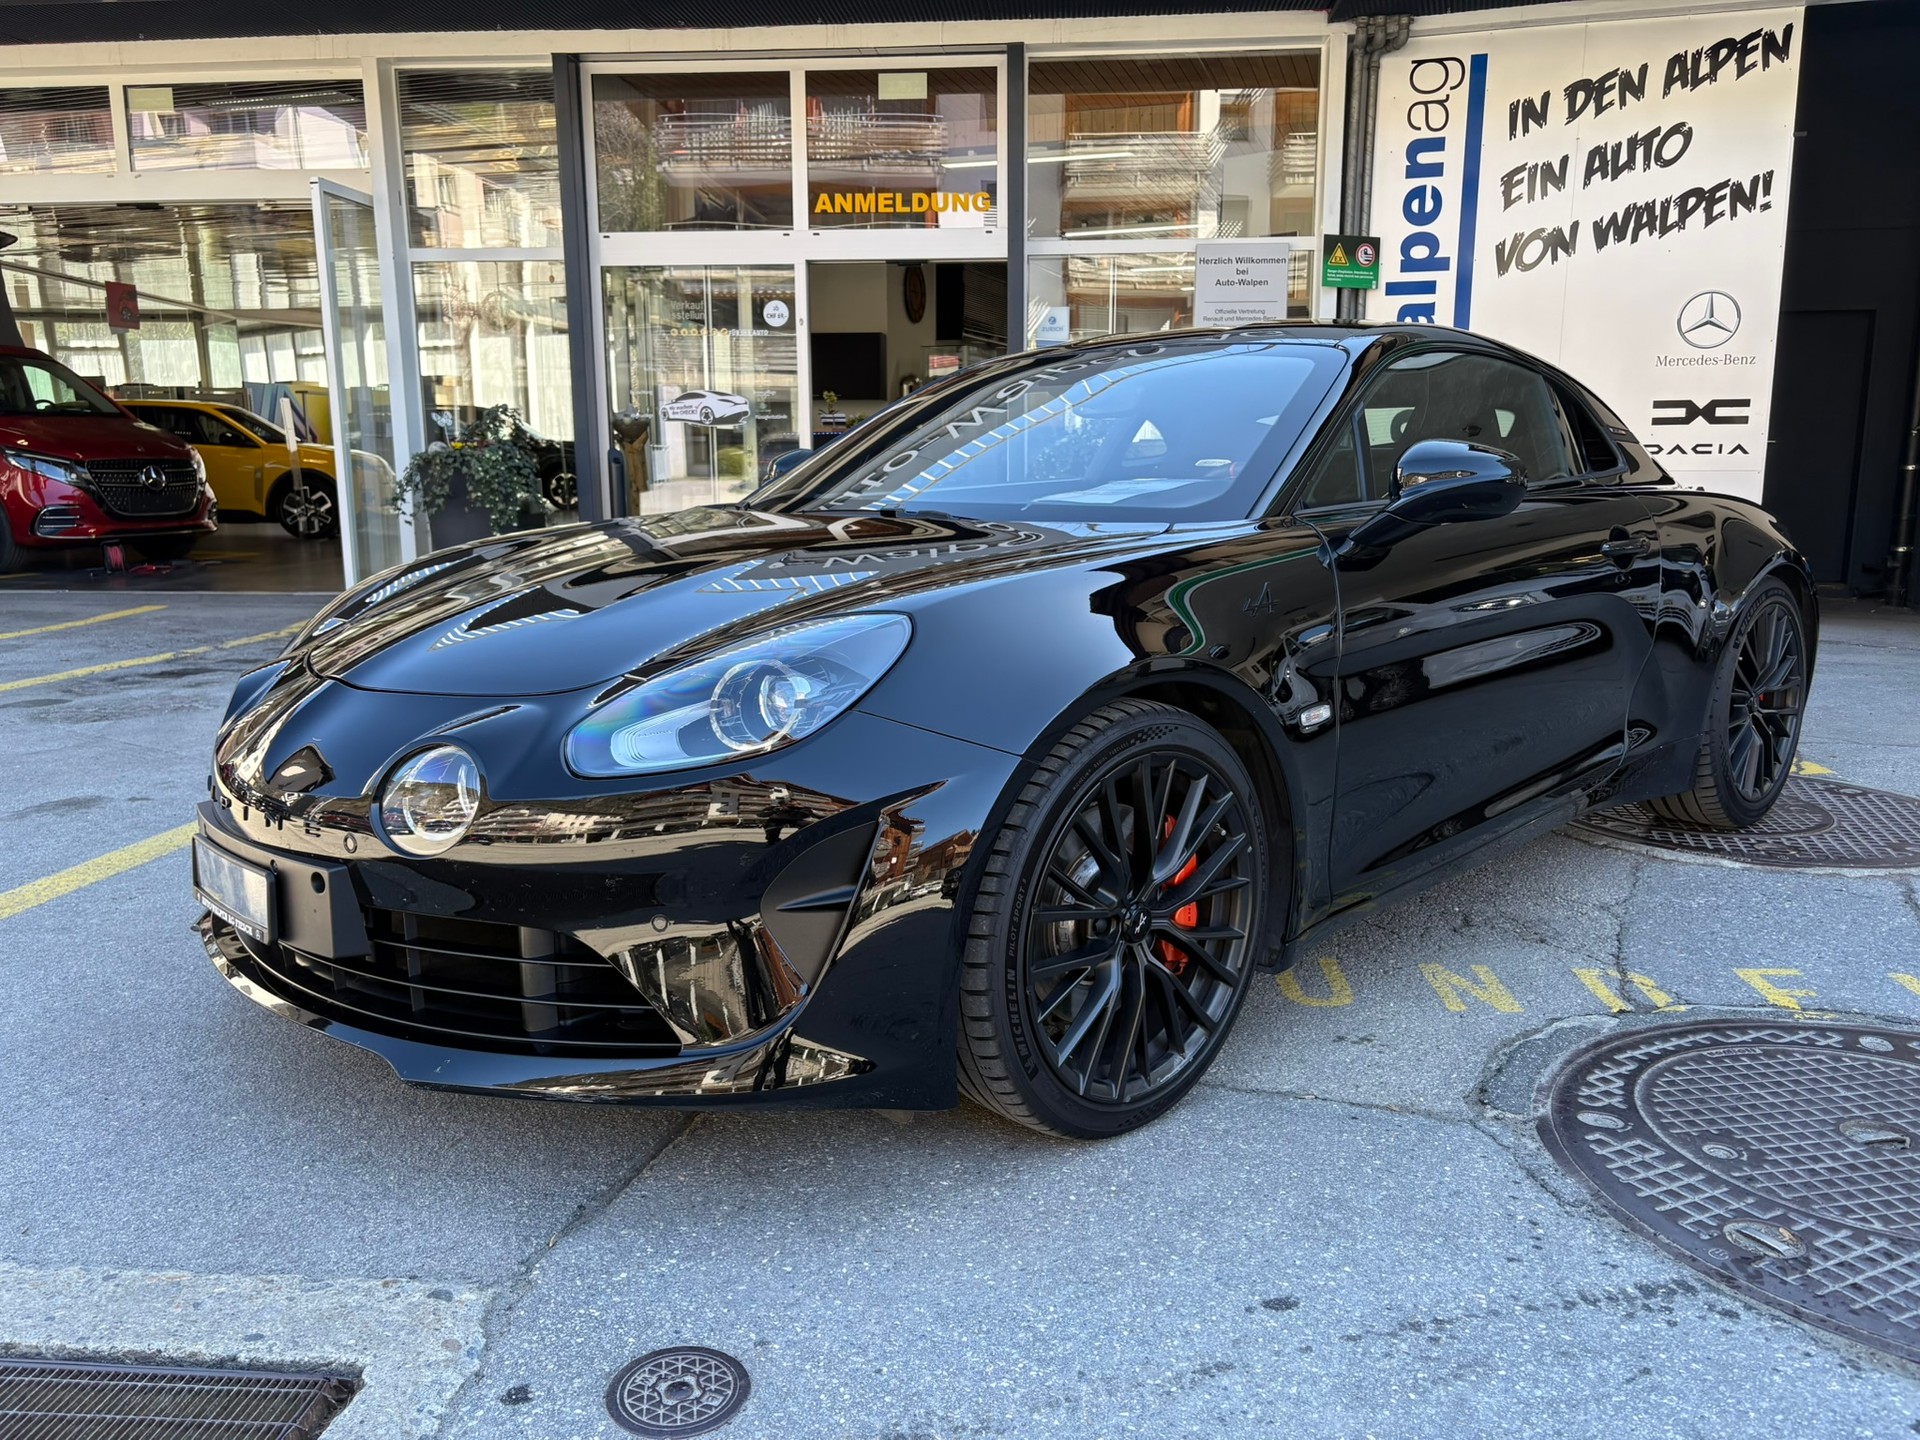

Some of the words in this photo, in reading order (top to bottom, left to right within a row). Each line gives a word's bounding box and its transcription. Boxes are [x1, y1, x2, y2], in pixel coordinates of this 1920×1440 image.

[1509, 91, 1551, 141] IN
[1564, 62, 1649, 126] DEN
[1663, 22, 1794, 100] ALPEN
[1501, 153, 1570, 212] EIN
[1583, 121, 1693, 190] AUTO
[814, 191, 991, 213] ANMELDUNG
[1496, 219, 1580, 278] VON
[1593, 169, 1775, 253] WALPEN!
[1199, 256, 1233, 265] Herzlich
[1235, 255, 1287, 264] Willkommen
[1236, 267, 1249, 275] bei
[1215, 278, 1269, 287] Auto-Walpen
[1238, 308, 1266, 316] Vertretung
[1655, 353, 1757, 367] Mercedes-Benz
[1643, 443, 1750, 455] DACIA
[1012, 887, 1026, 923] SPORT
[1008, 925, 1017, 957] PILOT
[1007, 968, 1030, 1057] MICHELIN
